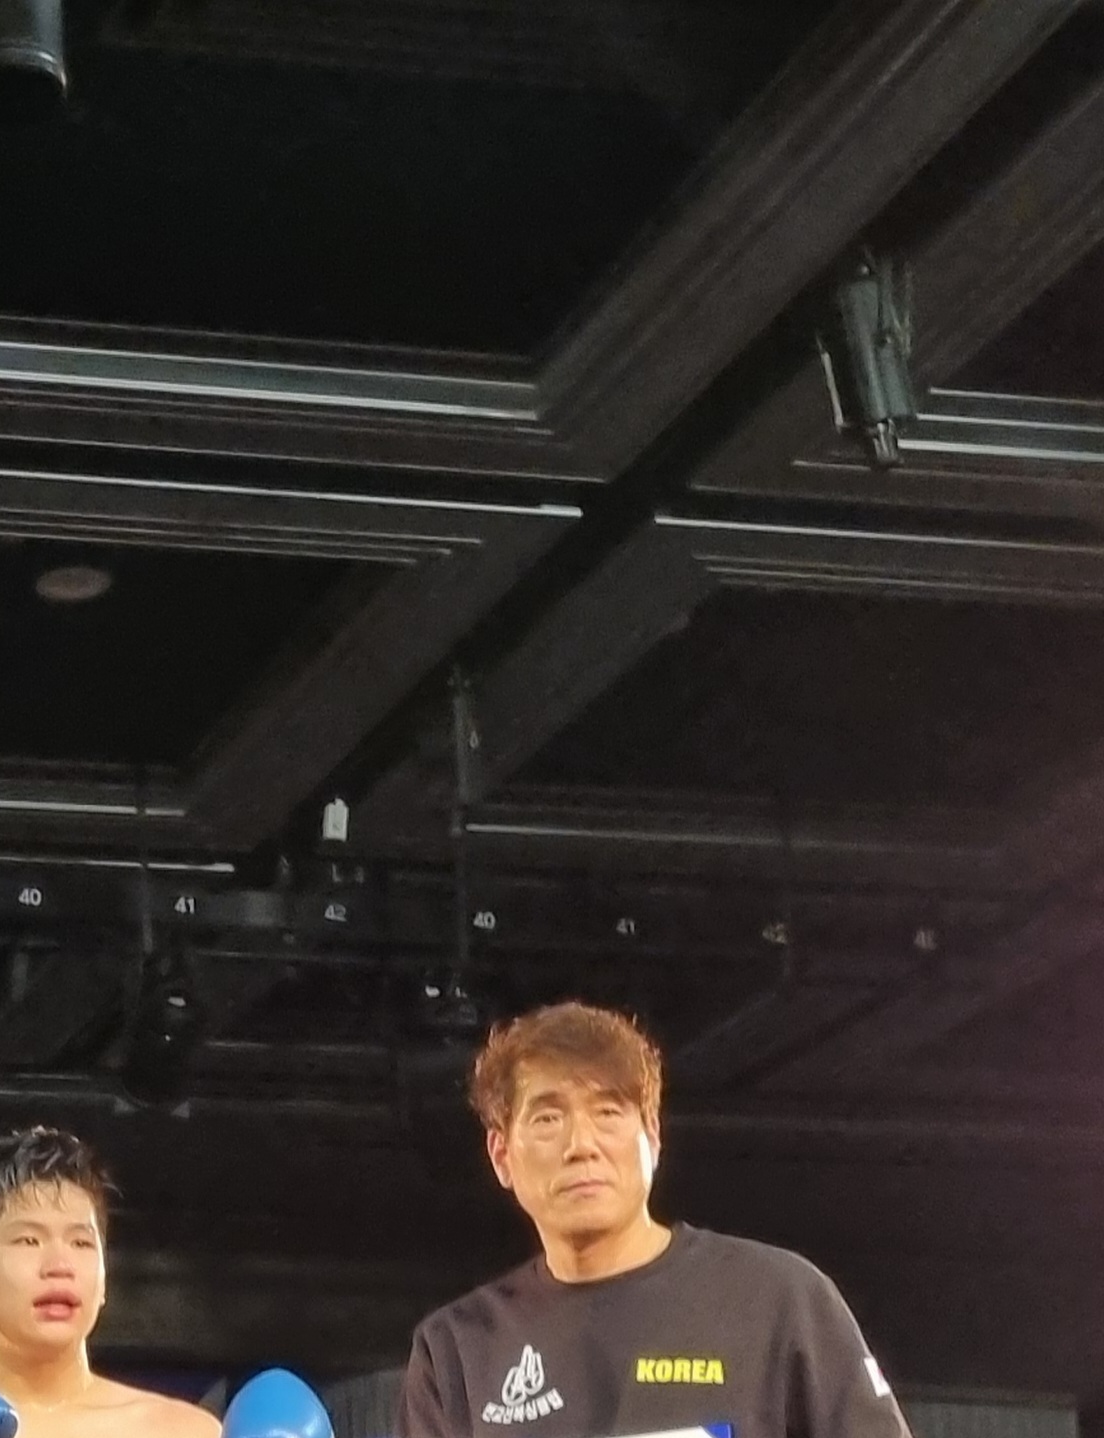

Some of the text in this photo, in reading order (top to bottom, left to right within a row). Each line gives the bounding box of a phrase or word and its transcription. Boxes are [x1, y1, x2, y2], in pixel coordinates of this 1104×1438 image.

[18, 888, 42, 906] 40
[174, 896, 195, 914] 41
[473, 911, 496, 930] 40
[636, 1358, 724, 1384] KOREA
